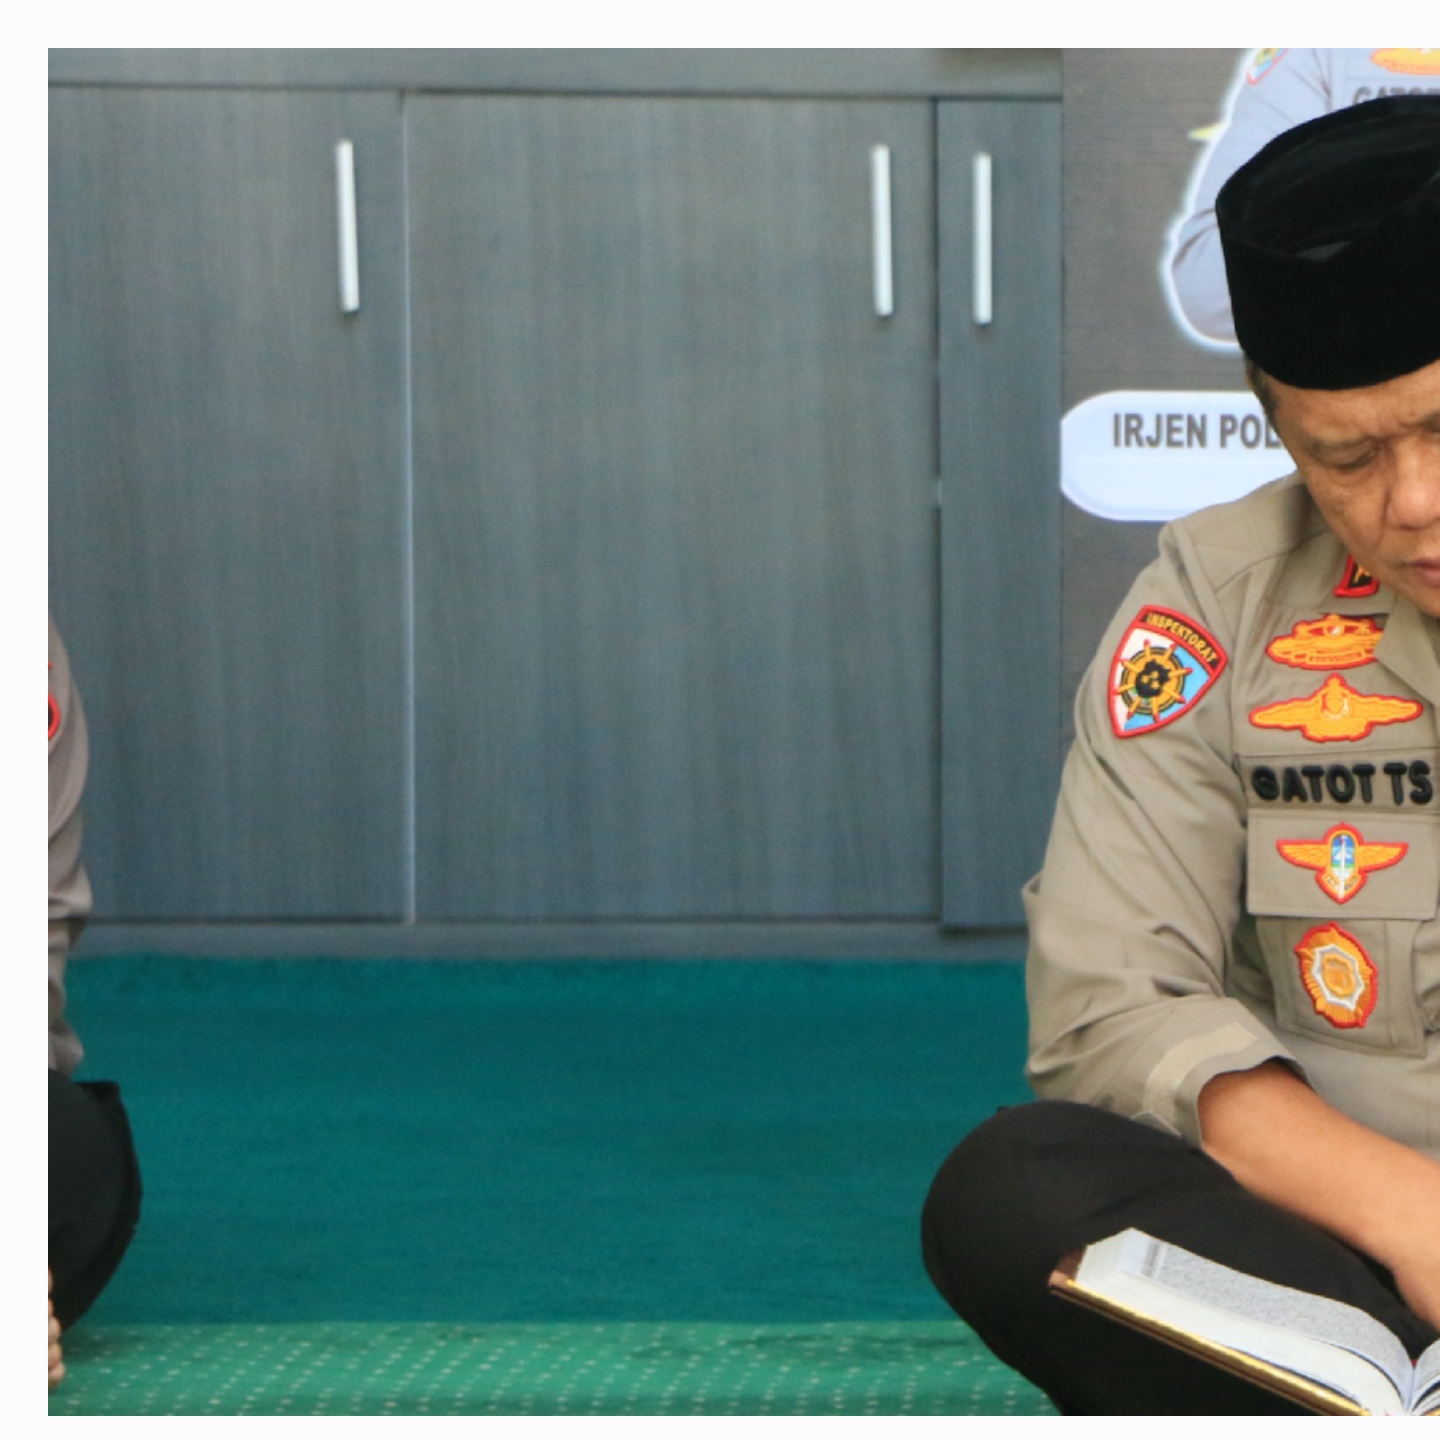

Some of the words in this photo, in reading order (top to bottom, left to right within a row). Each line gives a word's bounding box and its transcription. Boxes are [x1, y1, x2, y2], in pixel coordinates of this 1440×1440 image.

[1113, 412, 1207, 448] IRJEN
[1146, 612, 1218, 662] INSPEKTORAT
[1252, 764, 1376, 804] GATOT
[1383, 760, 1434, 805] TS
